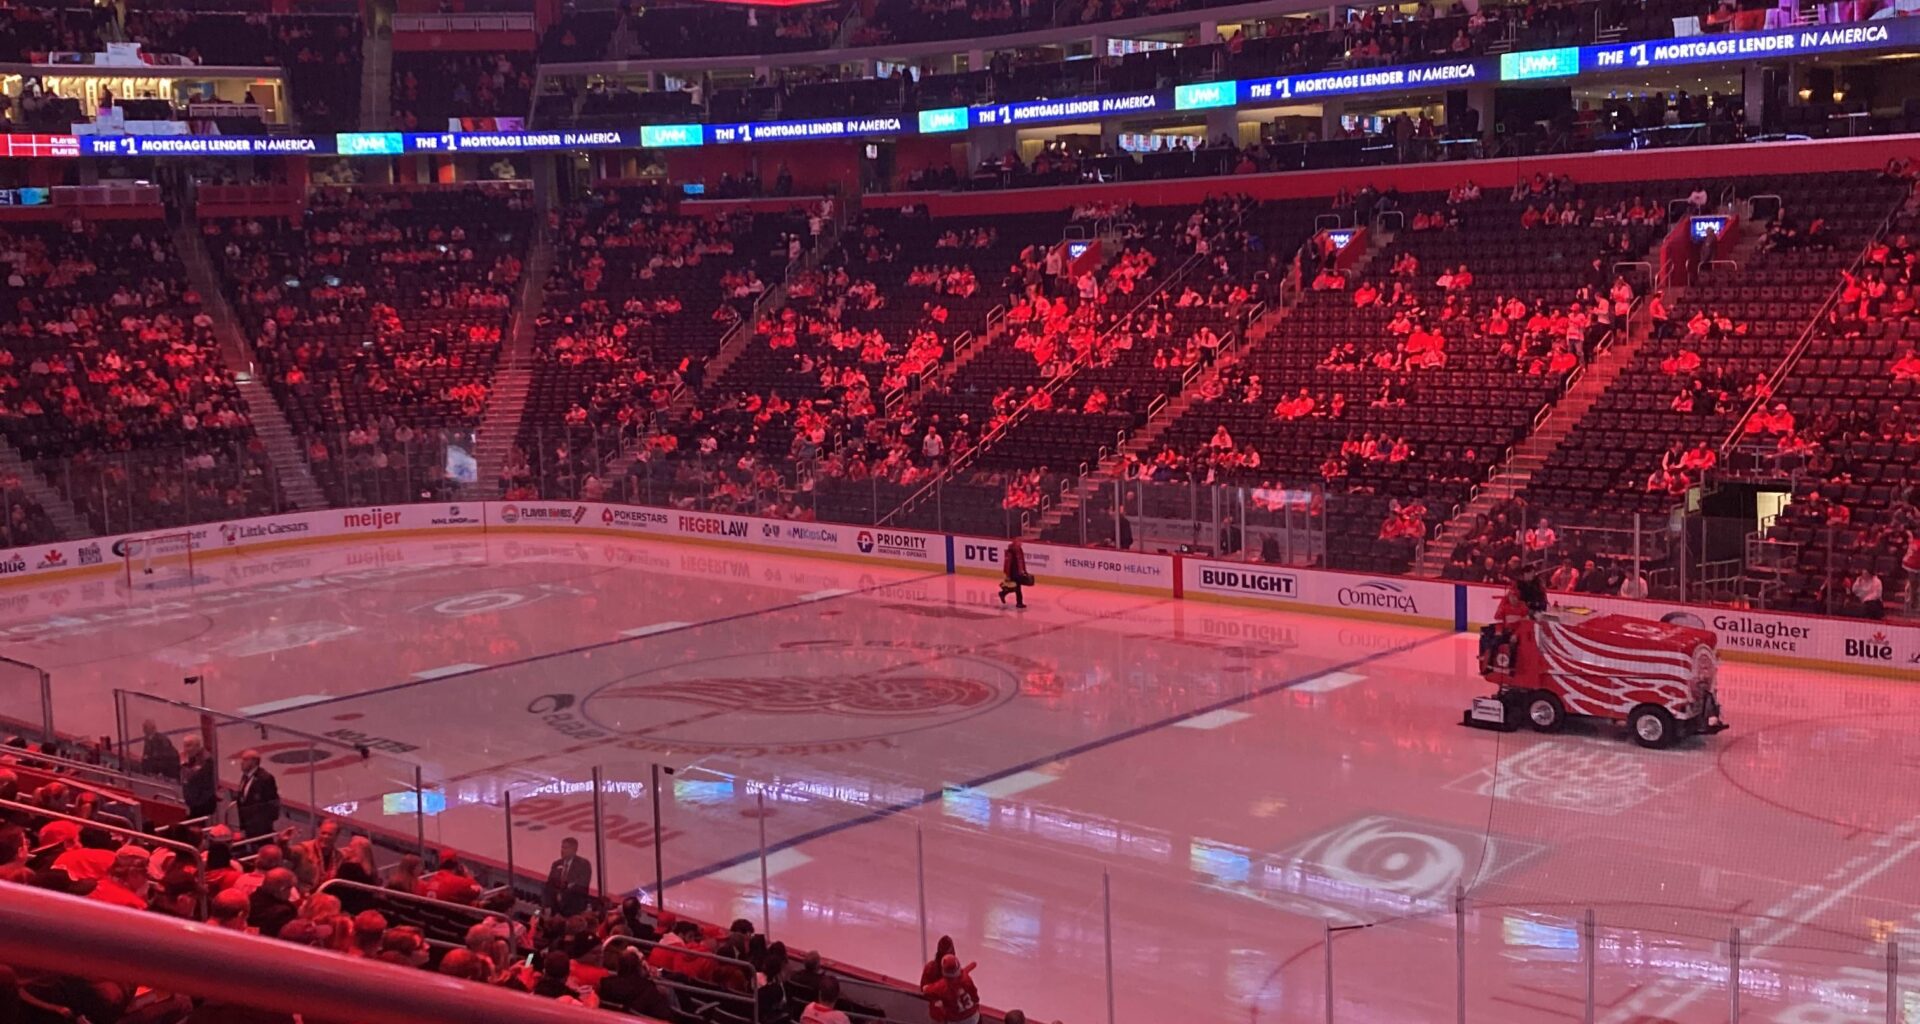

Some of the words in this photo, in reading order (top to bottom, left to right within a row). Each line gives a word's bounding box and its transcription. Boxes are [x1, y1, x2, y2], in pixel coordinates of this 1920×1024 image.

[1598, 50, 1624, 65] THE
[1655, 41, 1736, 60] MORTGAGE
[1739, 36, 1794, 53] LENDER
[1801, 32, 1818, 47] IN
[1820, 26, 1888, 45] AMERICA
[1519, 54, 1557, 75] UWM
[1251, 84, 1271, 97] THE
[1295, 75, 1358, 92] MORTGAGE
[1360, 71, 1403, 87] LENDER
[1408, 70, 1421, 82] IN
[1423, 64, 1475, 81] AMERICA
[1189, 88, 1219, 105] UWM
[979, 111, 995, 123] THE
[1014, 106, 1064, 119] MORTGAGE
[1065, 100, 1099, 114] LENDER
[1103, 99, 1115, 110] IN
[1114, 95, 1155, 110] AMERICA
[655, 129, 686, 143] UWM
[716, 129, 734, 140] THE
[755, 124, 807, 137] MORTGAGE
[808, 122, 844, 134] LENDER
[847, 121, 858, 132] IN
[859, 119, 900, 131] AMERICA
[93, 141, 116, 152] THE
[142, 140, 207, 151] MORTGAGE
[208, 140, 250, 151] LENDER
[254, 140, 266, 150] IN
[268, 140, 315, 150] AMERICA
[416, 137, 437, 148] THE
[461, 136, 521, 147] MORTGAGE
[523, 135, 561, 146] LENDER
[564, 134, 576, 144] IN
[577, 133, 620, 144] AMERICA
[51, 147, 78, 155] PLAYER
[344, 508, 401, 530] meijer
[614, 510, 668, 524] POKERSTARS
[240, 524, 267, 539] Little
[267, 521, 309, 536] Caesars
[877, 533, 926, 549] PRIORITY
[965, 544, 998, 563] DTE
[1064, 558, 1096, 569] HENRY
[1098, 561, 1122, 572] FORD
[1124, 564, 1161, 576] HEALTH
[1203, 570, 1239, 587] BUD
[1241, 573, 1293, 593] LIGHT
[1713, 615, 1811, 640] Gallagher
[1726, 635, 1797, 652] INSURANCE
[1845, 637, 1893, 660] Blue
[510, 799, 686, 849] meijer
